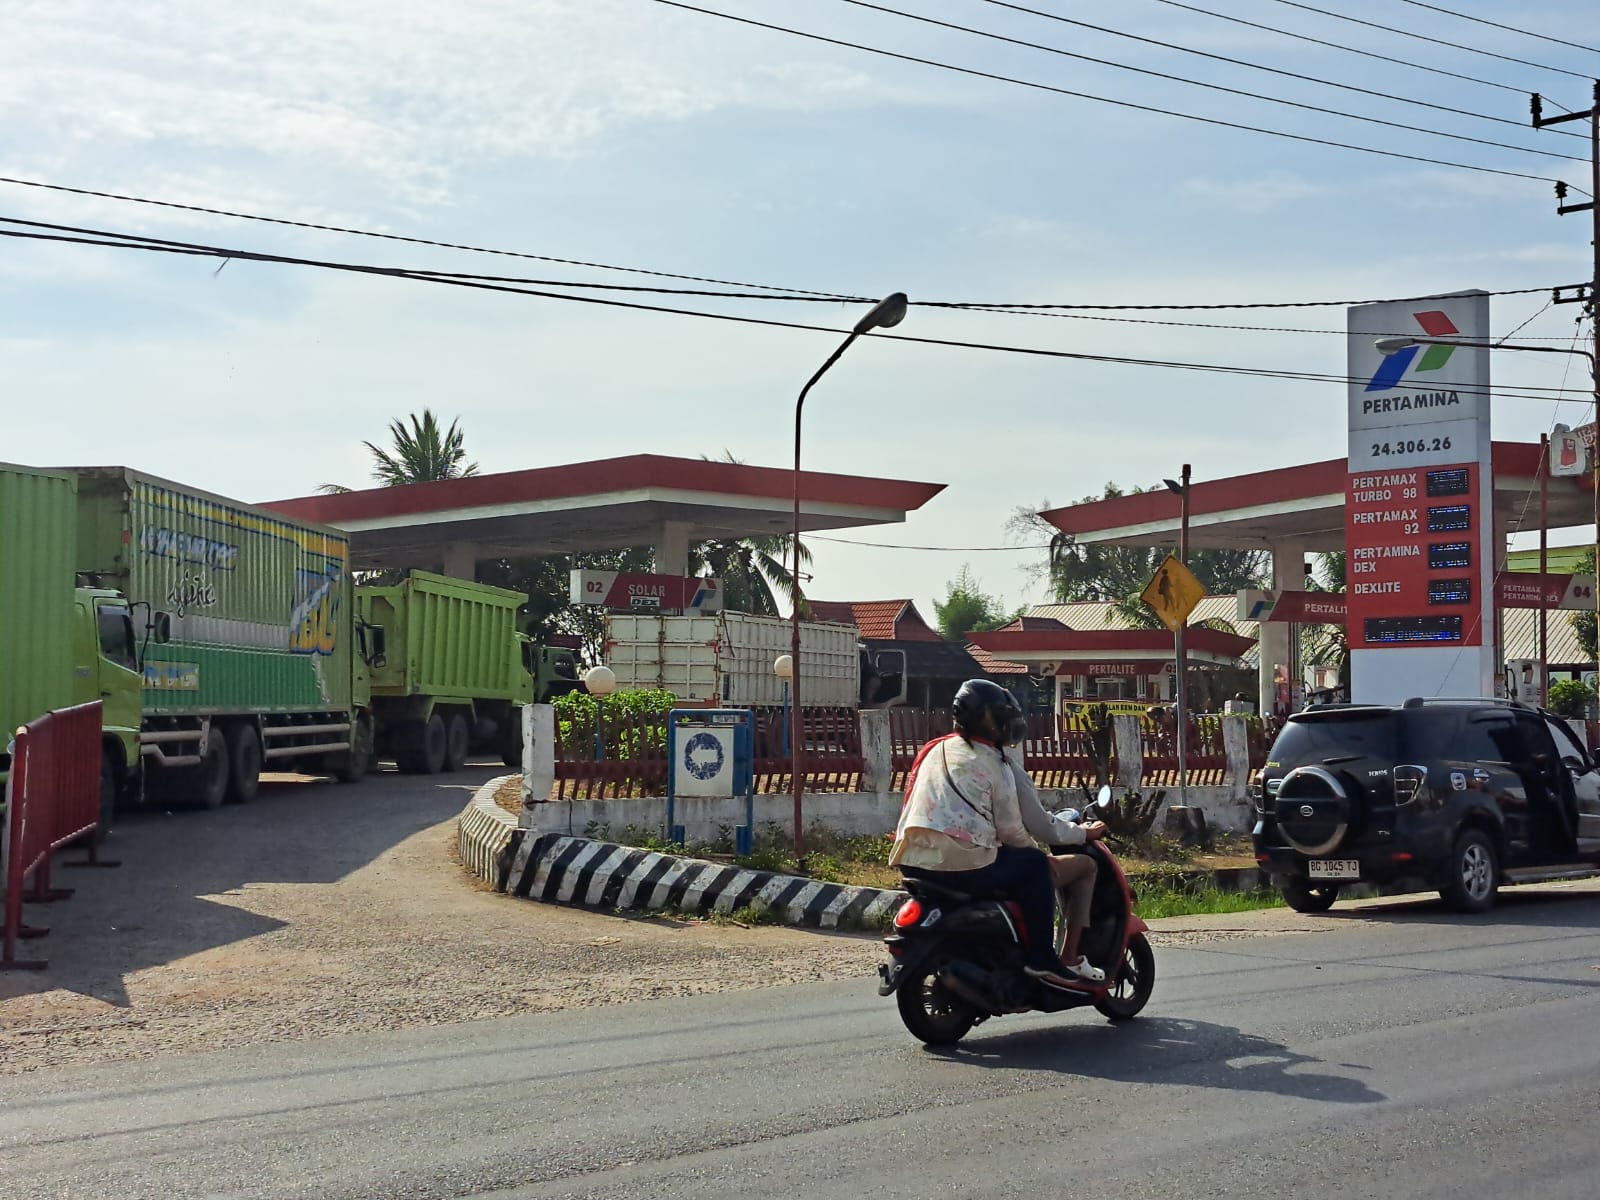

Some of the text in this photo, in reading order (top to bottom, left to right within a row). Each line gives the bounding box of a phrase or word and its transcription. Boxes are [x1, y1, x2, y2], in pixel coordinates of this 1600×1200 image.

[1363, 390, 1460, 414] PERTAMINA
[1371, 436, 1452, 457] 24.306.26
[1352, 473, 1417, 489] PERTAMAX
[1353, 487, 1417, 503] TURBO 98
[1353, 509, 1418, 524] PERTAMAX
[1404, 523, 1420, 535] 92
[1353, 544, 1420, 559] PERTAMINA
[1353, 561, 1376, 573] DEX
[586, 581, 603, 593] 02
[628, 584, 665, 597] SOLAR
[1354, 581, 1401, 594] DEXLITE
[1503, 584, 1541, 593] PERTAMAX
[1573, 585, 1591, 599] 04
[1503, 592, 1541, 601] PERTAMIN
[1304, 603, 1348, 615] PERTALIT
[1089, 664, 1136, 675] PERTALITE
[1324, 861, 1344, 871] 1045
[1347, 861, 1357, 871] TJ
